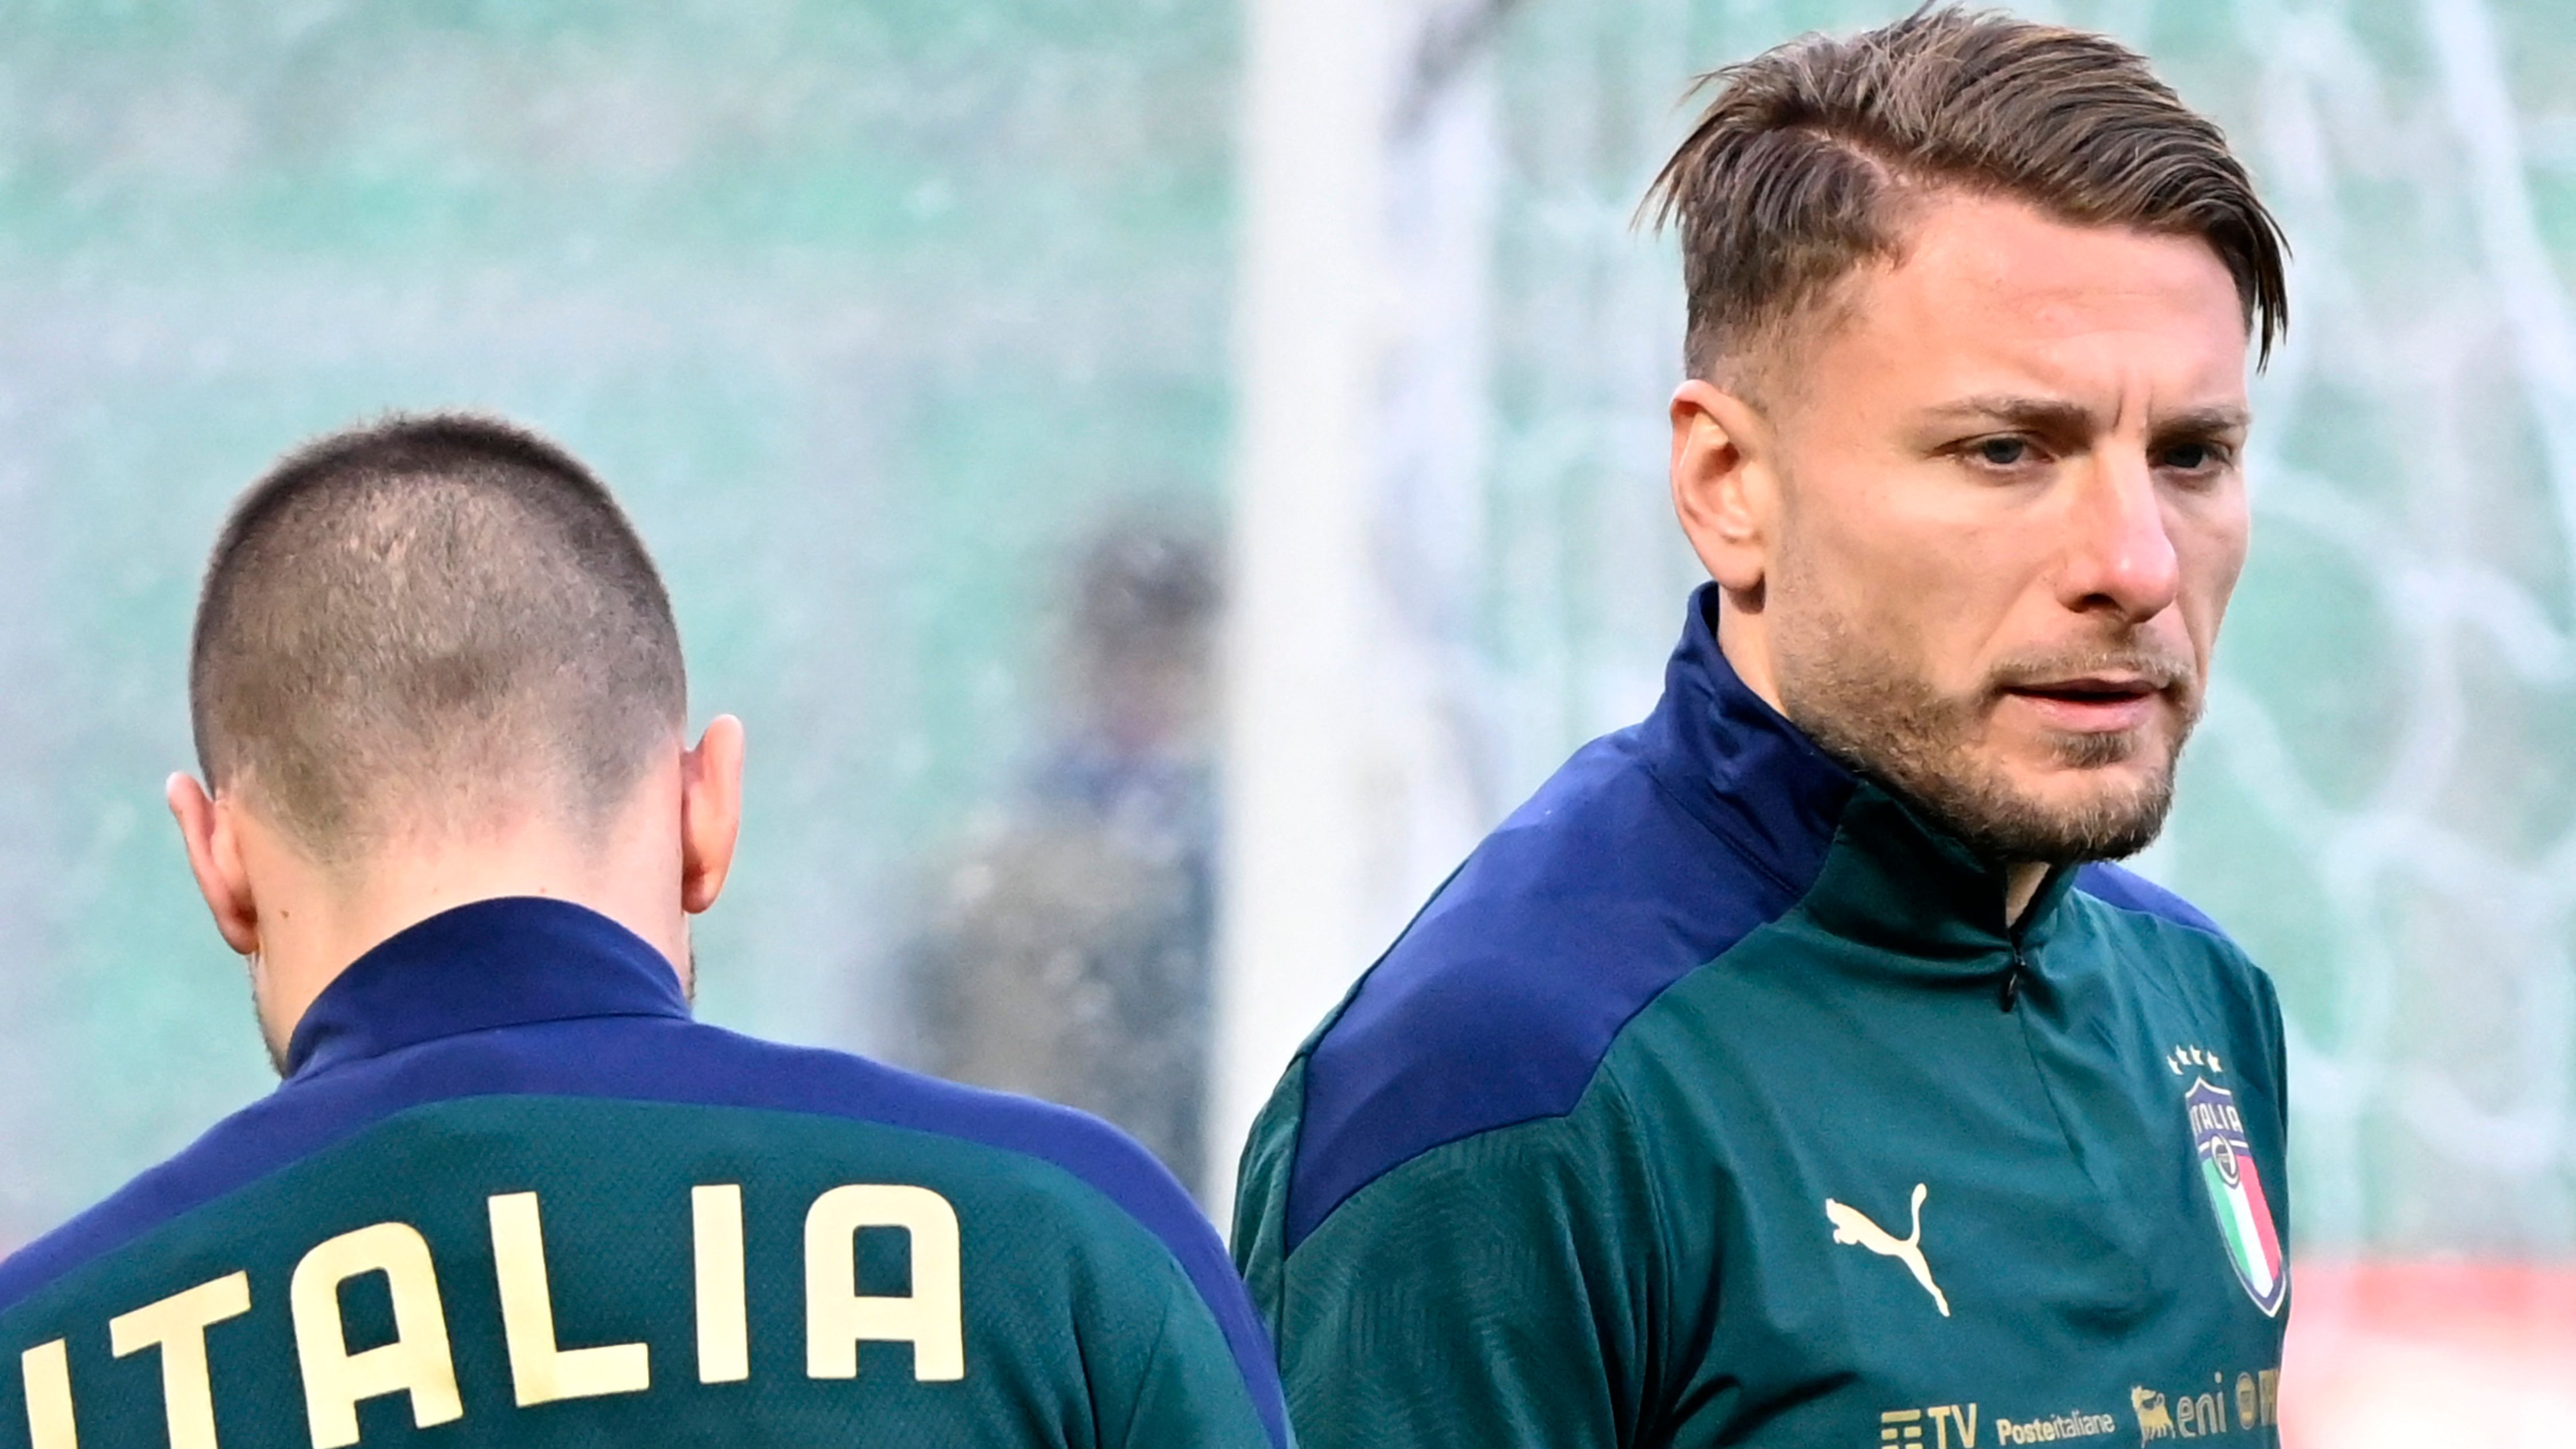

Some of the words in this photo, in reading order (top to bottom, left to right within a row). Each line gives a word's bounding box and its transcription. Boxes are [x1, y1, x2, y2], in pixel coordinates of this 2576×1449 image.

[21, 1183, 964, 1449] ITALIA
[1927, 1403, 1977, 1449] TV
[2176, 1371, 2227, 1438] eni
